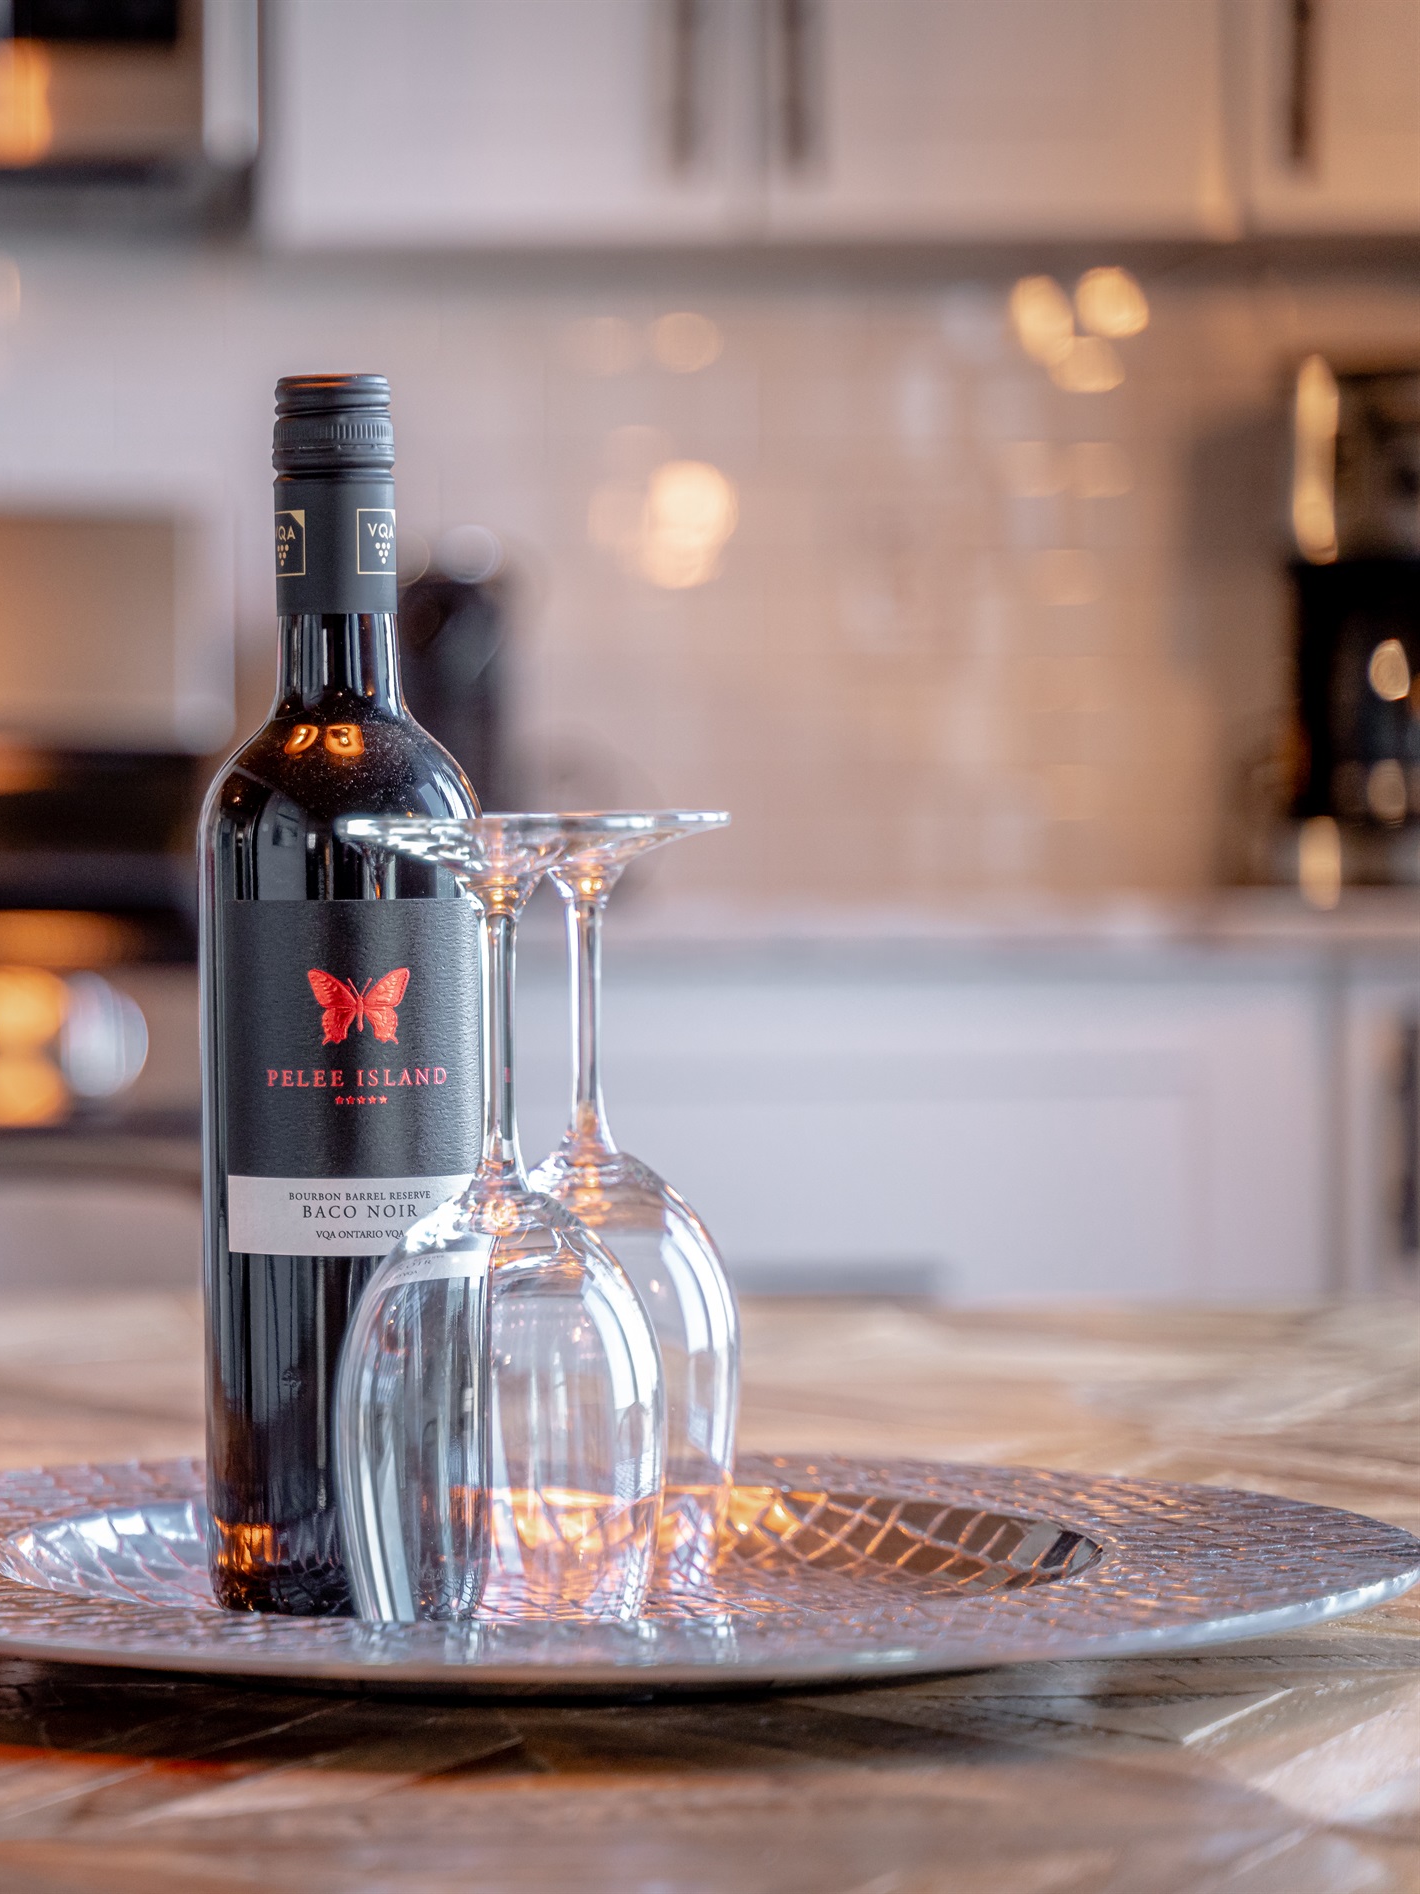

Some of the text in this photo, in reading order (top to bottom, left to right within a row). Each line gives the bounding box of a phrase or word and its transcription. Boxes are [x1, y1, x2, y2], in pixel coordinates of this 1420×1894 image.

[367, 523, 394, 540] VQA
[267, 1066, 447, 1087] PELEE ISLAND
[289, 1190, 431, 1201] BOURBON BARREL RESERVE
[302, 1204, 418, 1219] BACO NOIR
[316, 1229, 405, 1240] VQA ONTARIO VQA
